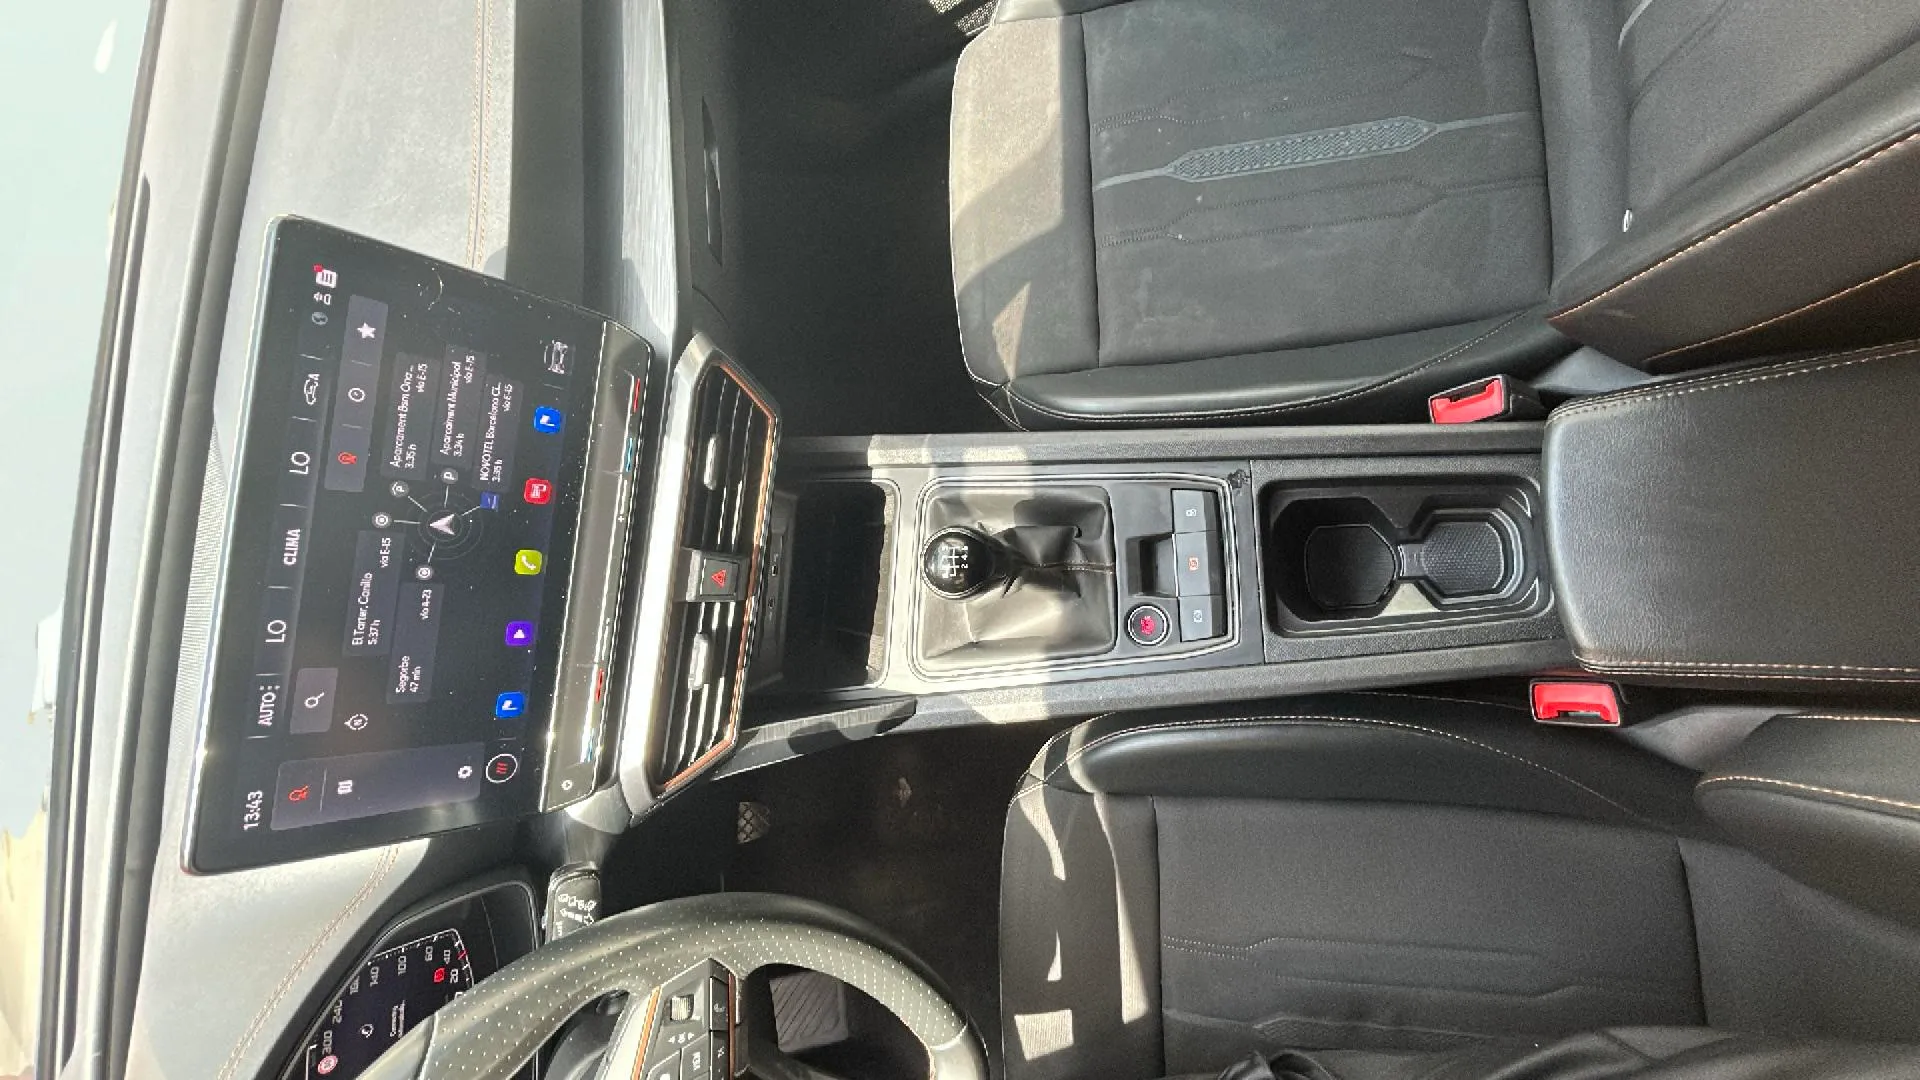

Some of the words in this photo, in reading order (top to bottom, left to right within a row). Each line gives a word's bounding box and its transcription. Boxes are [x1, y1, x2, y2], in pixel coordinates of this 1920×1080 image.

[416, 363, 428, 381] E-15
[465, 355, 475, 372] E-15
[446, 361, 462, 402] Municipal
[440, 403, 457, 455] Aparcament
[485, 398, 500, 439] Barcelona
[389, 413, 407, 468] Aparcament
[398, 393, 411, 413] Bsm
[288, 451, 311, 475] LO
[404, 450, 416, 469] 3:35
[479, 439, 495, 481] NOVOTEL
[283, 528, 301, 566] CLIMA
[380, 537, 391, 555] E-15
[265, 619, 287, 644] LO
[352, 636, 365, 646] El
[368, 626, 379, 646] 5:37
[395, 655, 410, 693] Segorbe
[411, 666, 422, 681] min
[410, 681, 420, 693] 47
[258, 692, 276, 726] AUTO
[243, 790, 263, 831] 13:43
[425, 946, 433, 962] 60
[443, 949, 451, 965] 40
[397, 955, 407, 976] 100
[369, 966, 380, 987] 140
[450, 969, 459, 984] 20
[321, 1030, 333, 1056] 300
